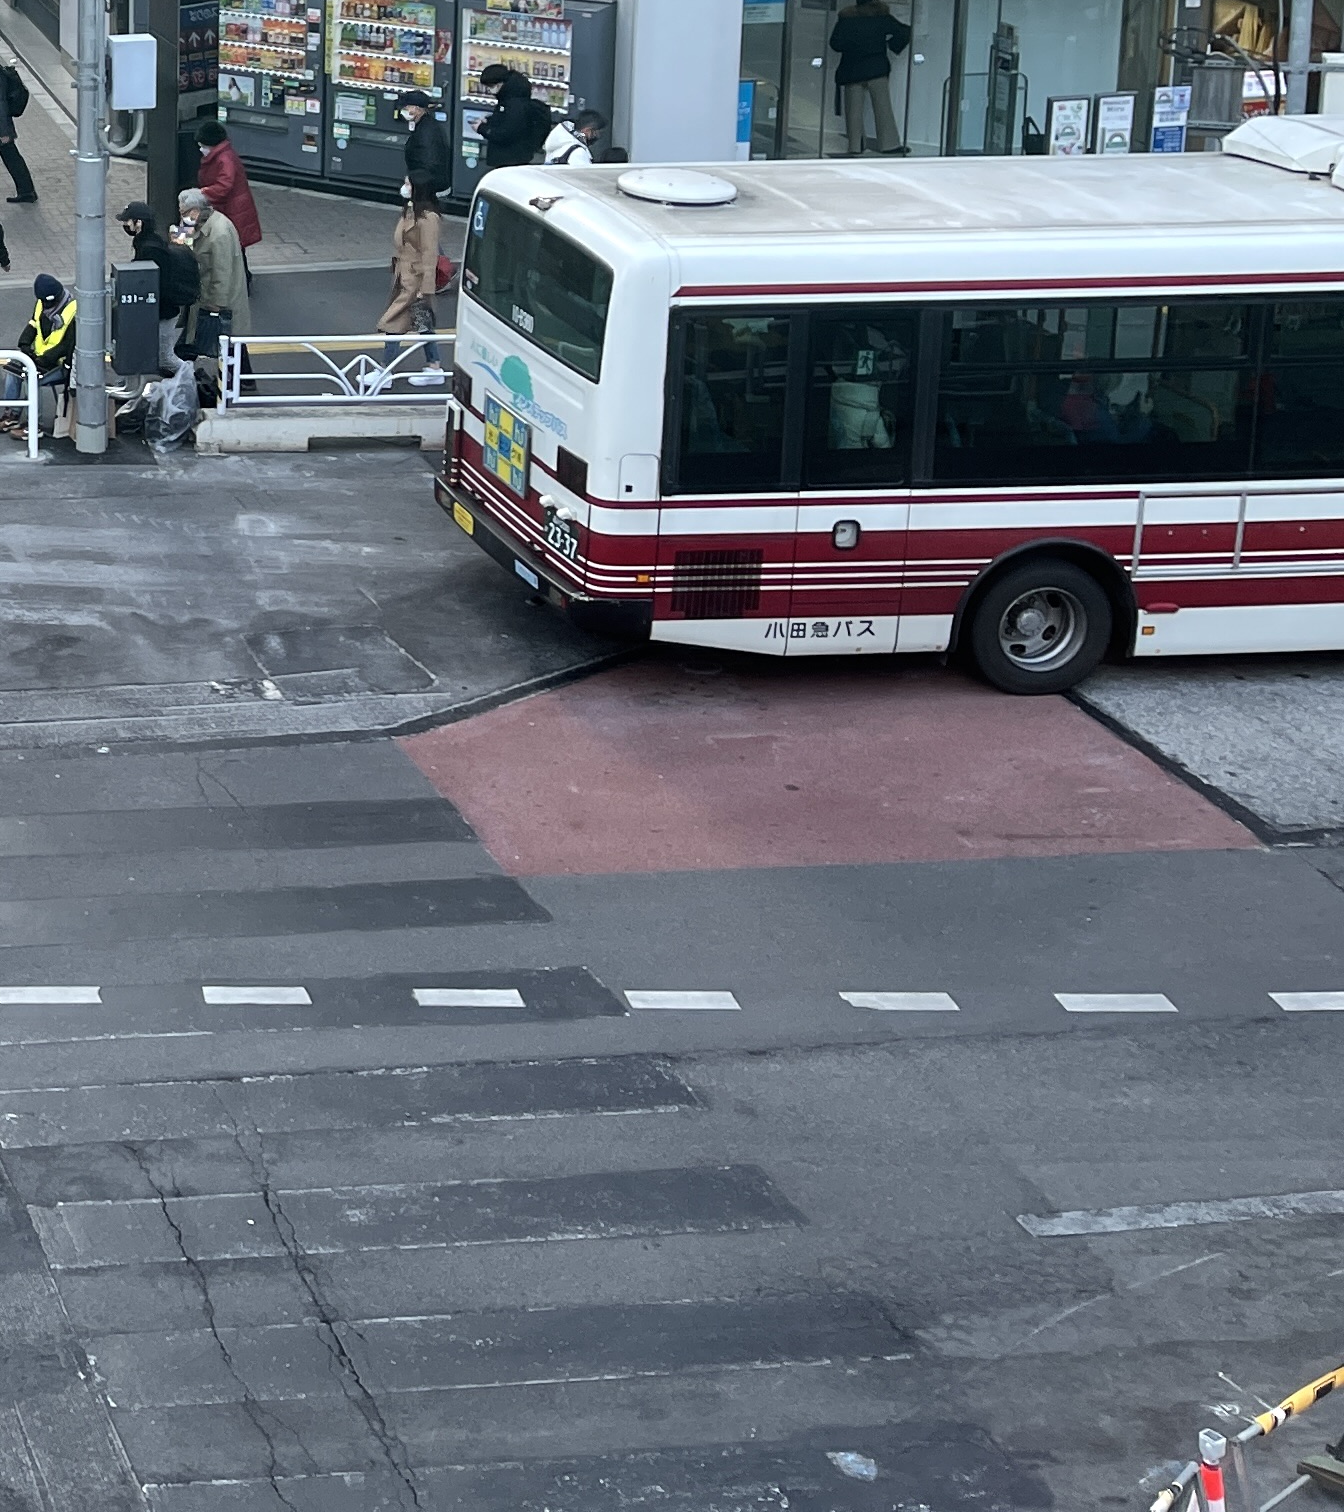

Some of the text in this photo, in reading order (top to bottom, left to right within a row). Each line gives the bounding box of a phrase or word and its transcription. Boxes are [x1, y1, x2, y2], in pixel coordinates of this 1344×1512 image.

[546, 521, 579, 560] 23-37
[764, 619, 876, 639] 小田急バス
